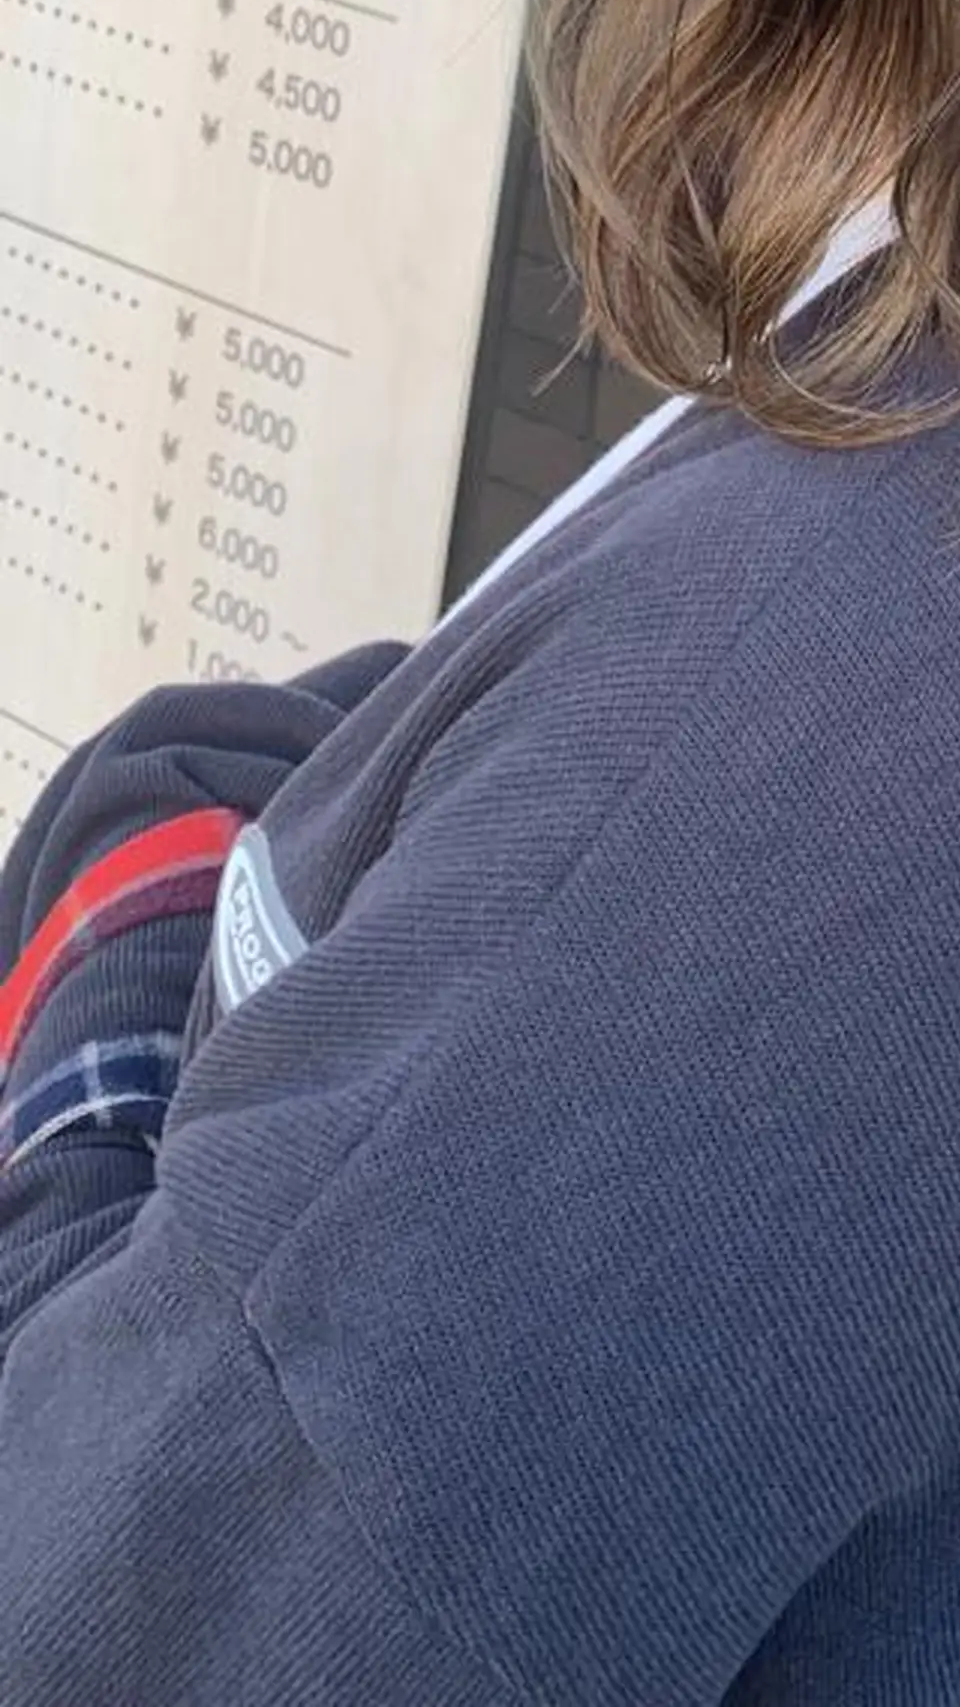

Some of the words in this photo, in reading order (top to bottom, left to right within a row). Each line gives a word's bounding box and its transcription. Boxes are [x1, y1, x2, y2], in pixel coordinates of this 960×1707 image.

[265, 3, 350, 57] 4,000
[256, 67, 341, 123] 4,500
[248, 130, 333, 189] 5,000
[222, 327, 305, 389] 5,000
[214, 391, 296, 453] 5,000
[206, 452, 287, 516] 5,000
[198, 516, 278, 579] 6,000
[190, 578, 269, 643] 2,000
